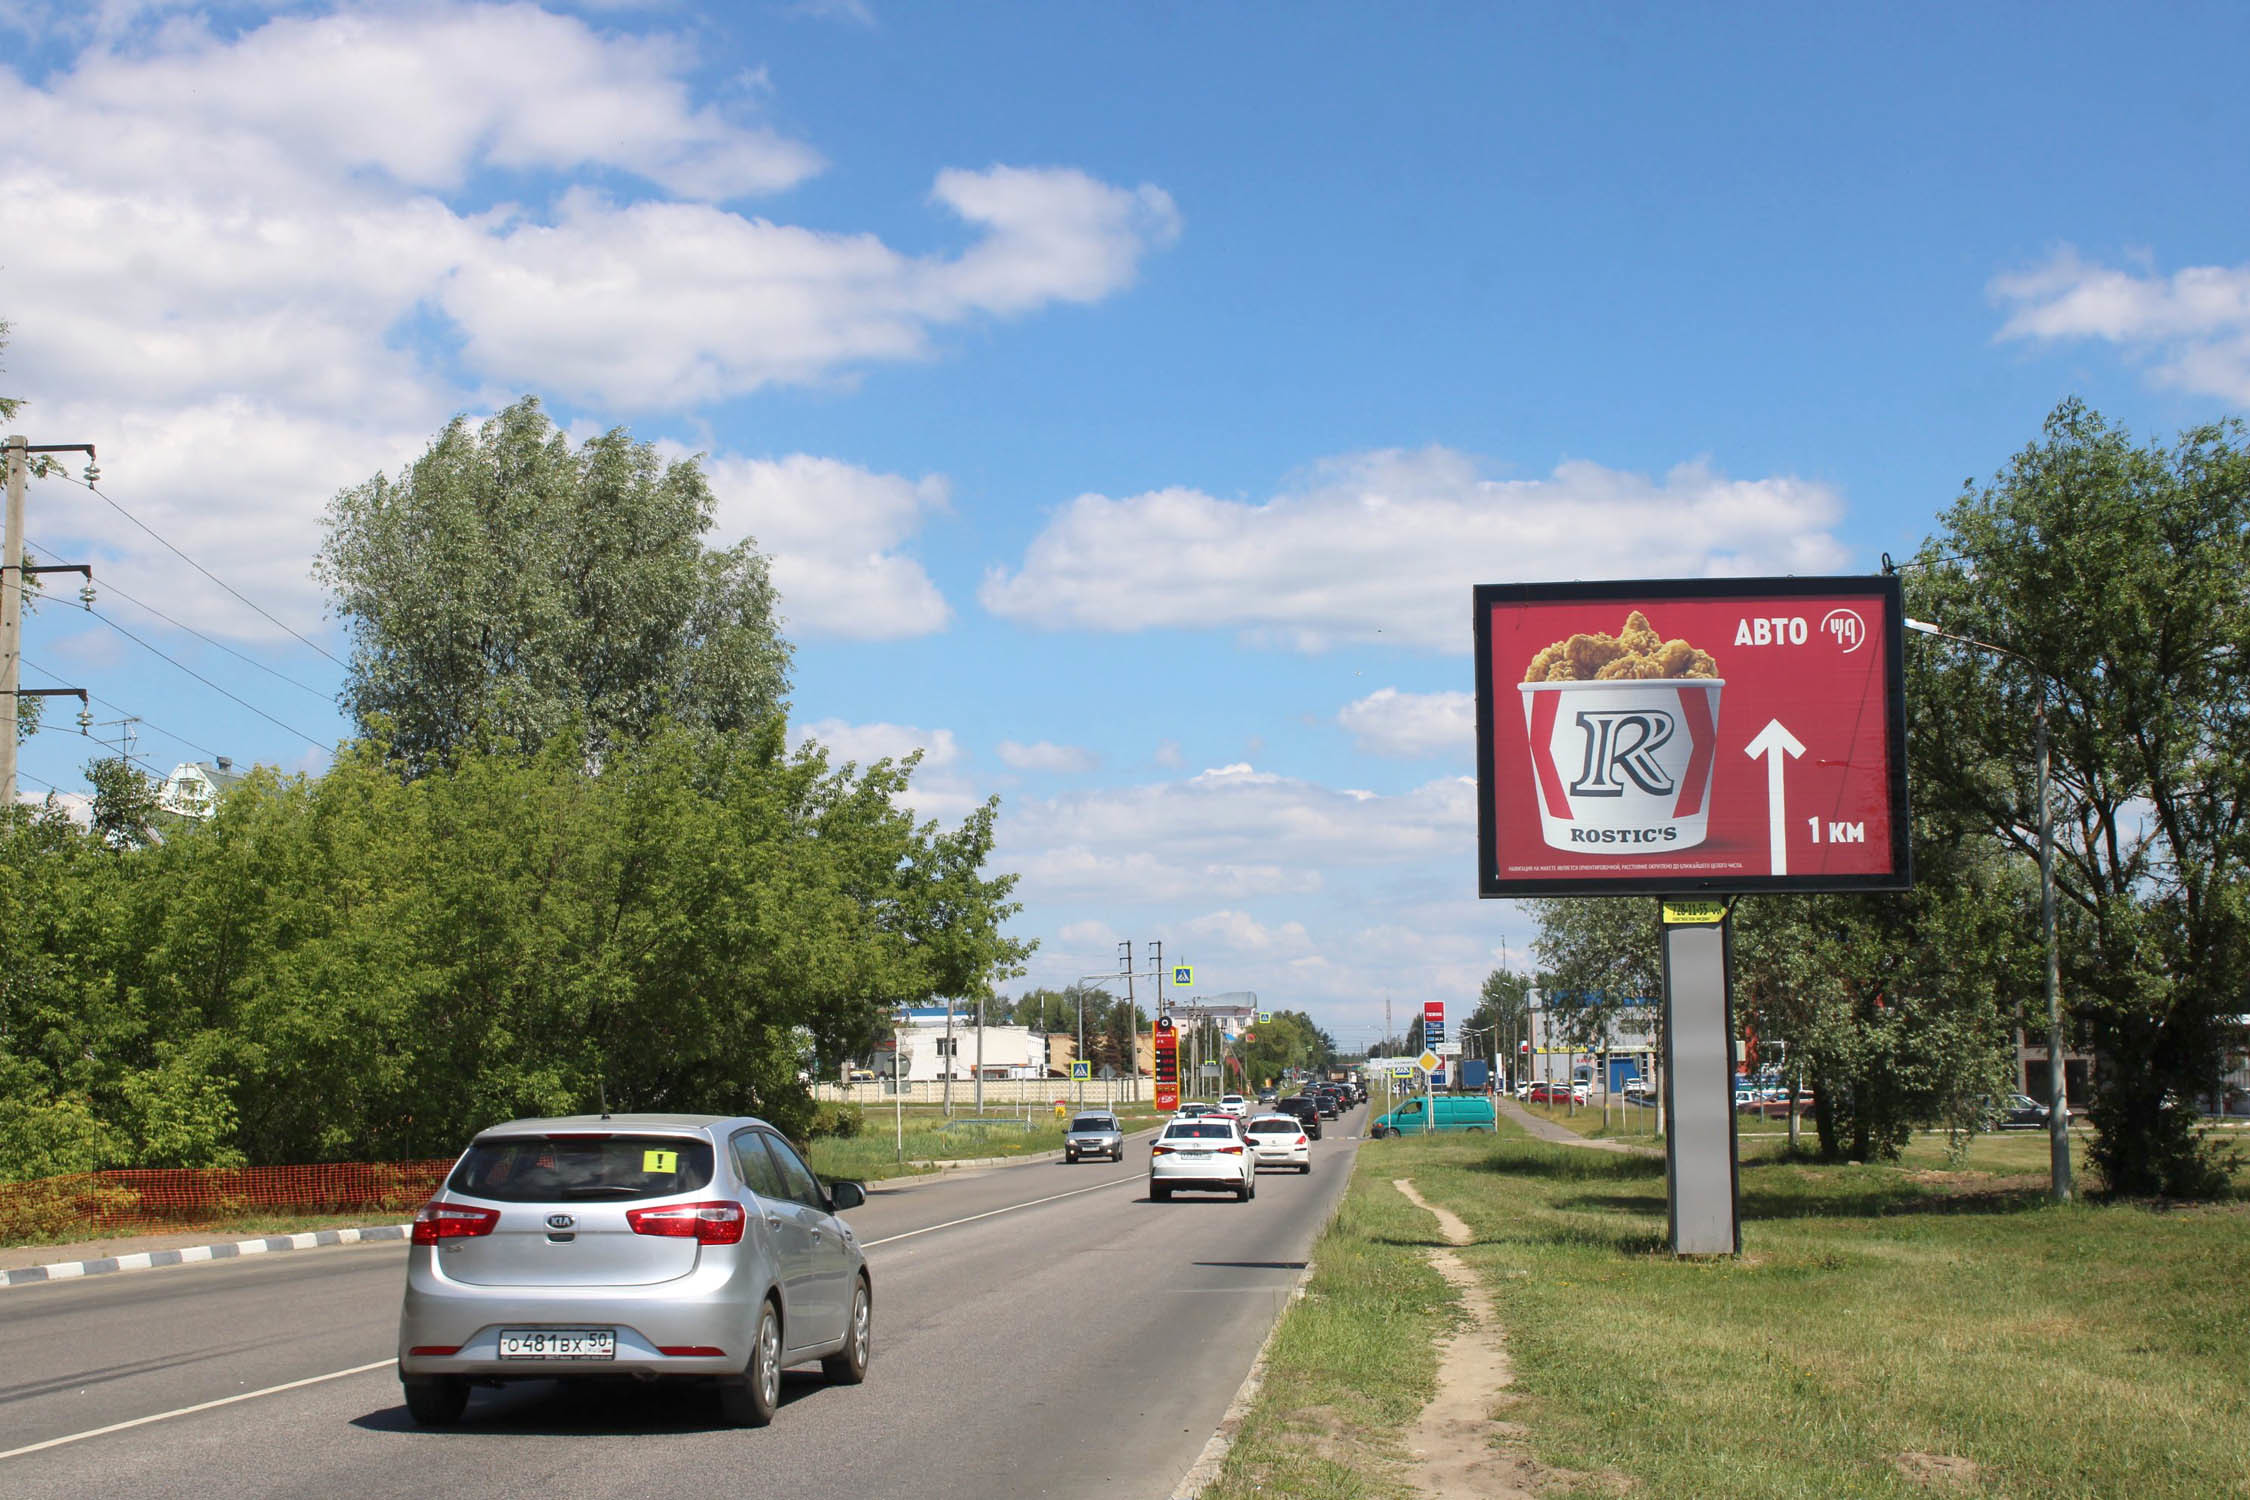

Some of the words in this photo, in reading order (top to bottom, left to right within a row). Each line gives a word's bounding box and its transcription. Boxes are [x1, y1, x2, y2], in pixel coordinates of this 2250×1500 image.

[1734, 617, 1808, 646] АВТО
[1570, 826, 1677, 843] ROSTIC'S
[1808, 815, 1820, 843] 1
[552, 1216, 570, 1226] KIA
[589, 1333, 607, 1347] 50
